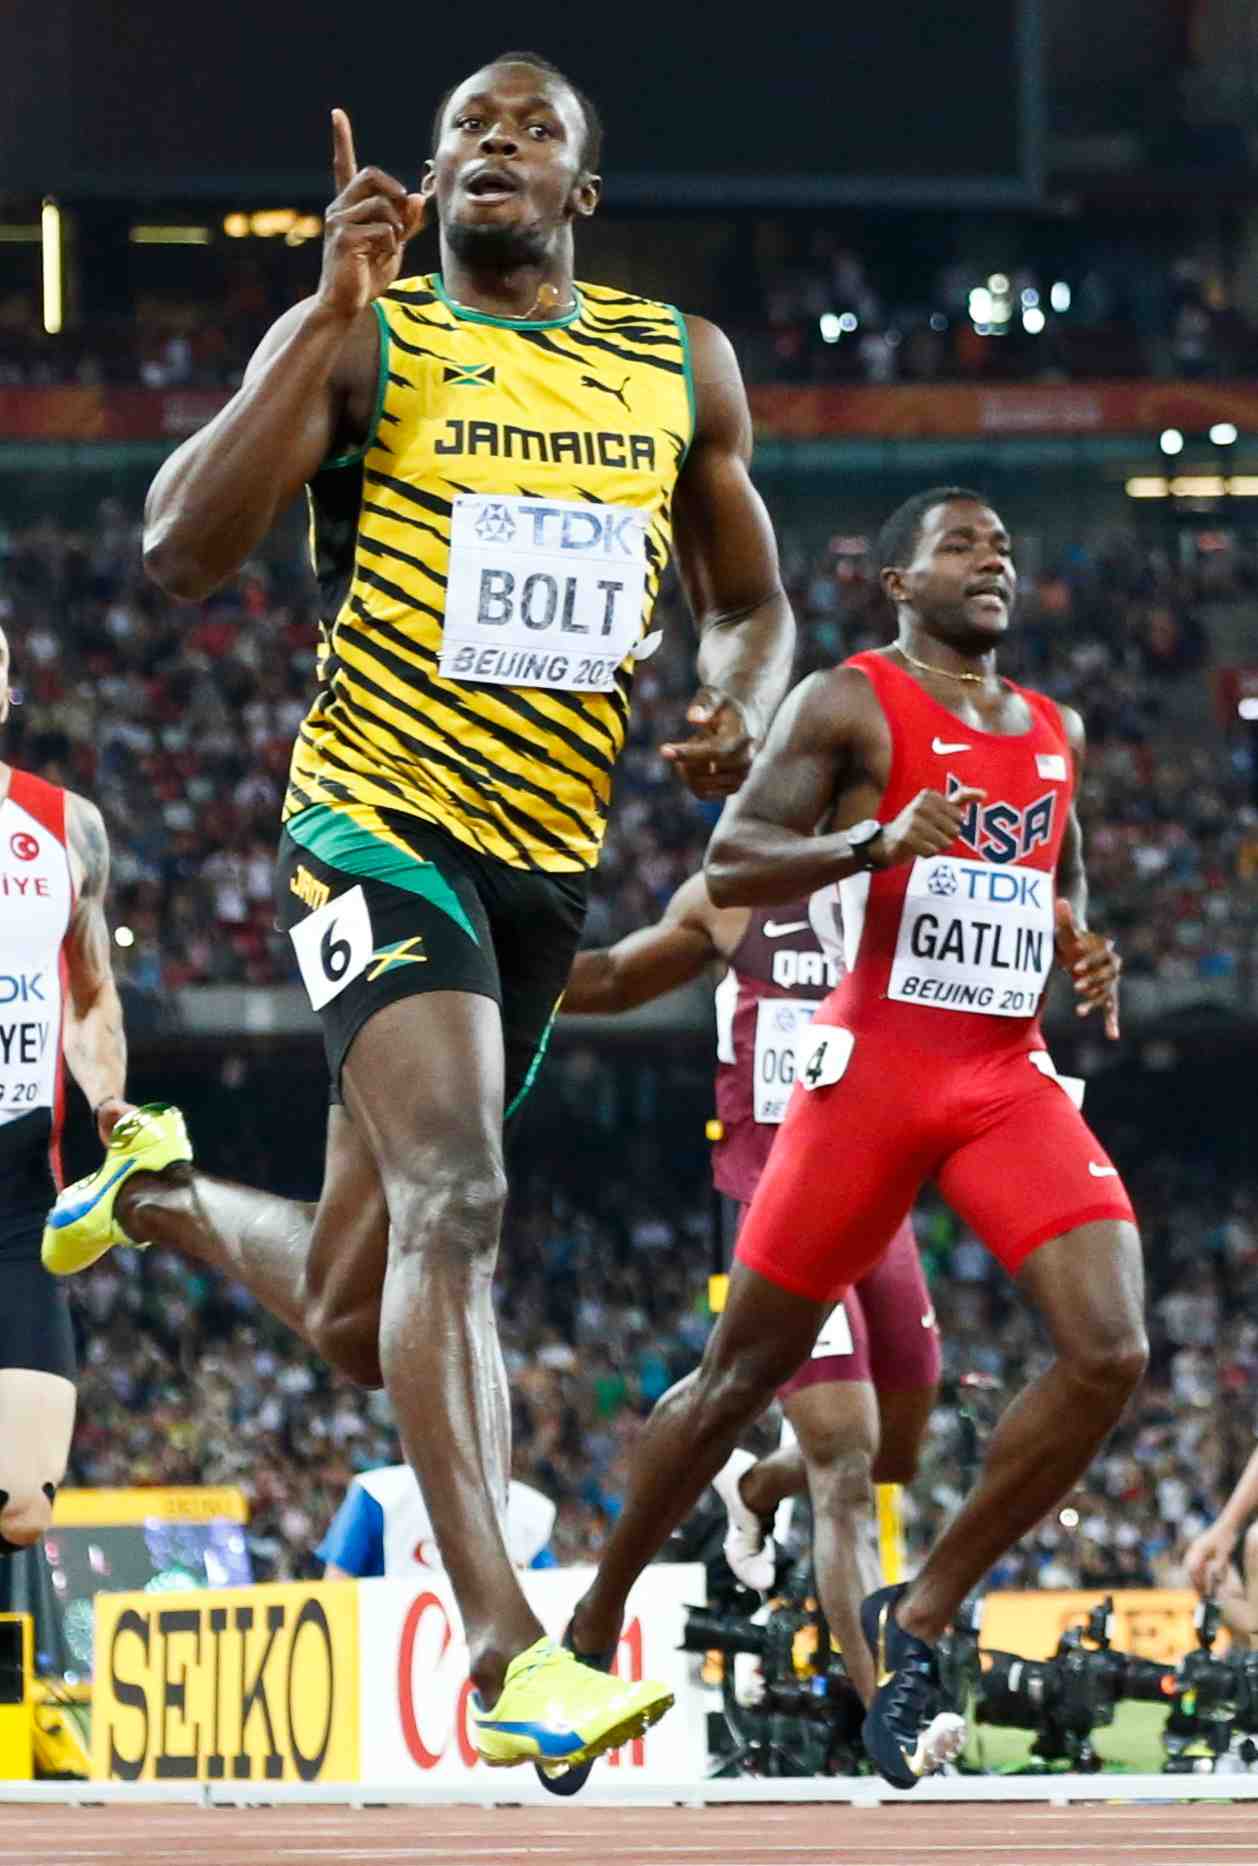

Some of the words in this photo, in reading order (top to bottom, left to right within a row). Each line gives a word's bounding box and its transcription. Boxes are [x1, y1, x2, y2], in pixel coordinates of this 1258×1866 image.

[434, 420, 656, 472] JAMAICA
[517, 506, 633, 555] TDK
[476, 567, 624, 637] BOLT
[452, 645, 569, 682] BEIJING
[960, 867, 1041, 909] TDK
[320, 916, 352, 982] 6
[911, 912, 1043, 973] GATLIN
[901, 976, 994, 1007] BEIJING
[805, 1041, 828, 1085] 4
[109, 1597, 335, 1782] SEIKO
